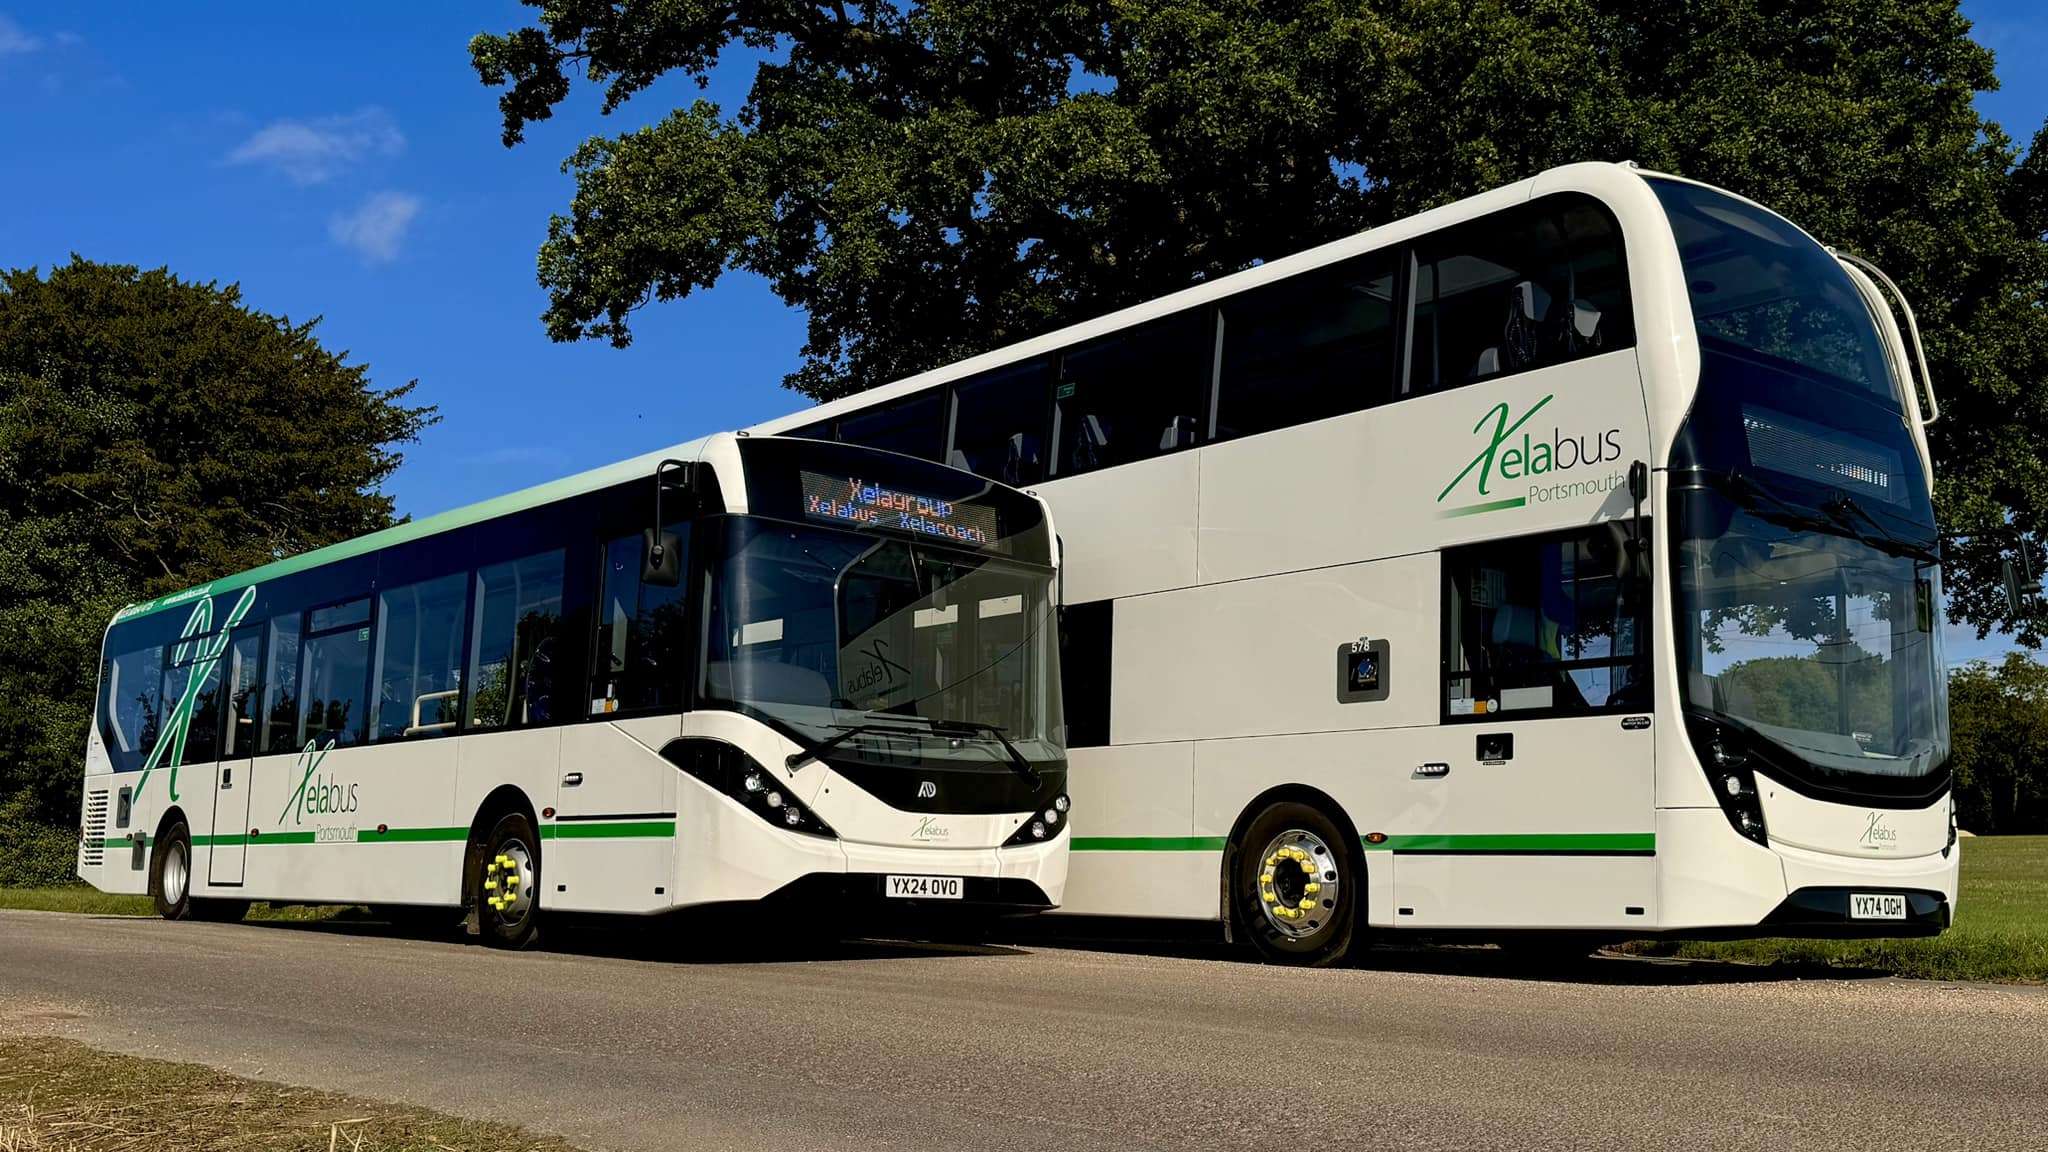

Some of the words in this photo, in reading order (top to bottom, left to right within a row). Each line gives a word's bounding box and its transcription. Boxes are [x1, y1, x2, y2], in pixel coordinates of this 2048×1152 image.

[1437, 394, 1621, 502] Xelabus
[849, 478, 953, 518] Xelagroup
[1528, 471, 1626, 504] Portsmouth
[809, 495, 878, 524] Xelabus
[899, 512, 986, 543] Xelacoach
[1351, 639, 1370, 653] 578
[279, 738, 358, 825] Xelabus
[315, 822, 358, 841] Portsmouth
[893, 878, 928, 895] YX24
[931, 879, 957, 895] OVO
[1855, 897, 1882, 915] YX74
[1884, 898, 1902, 915] OGH
